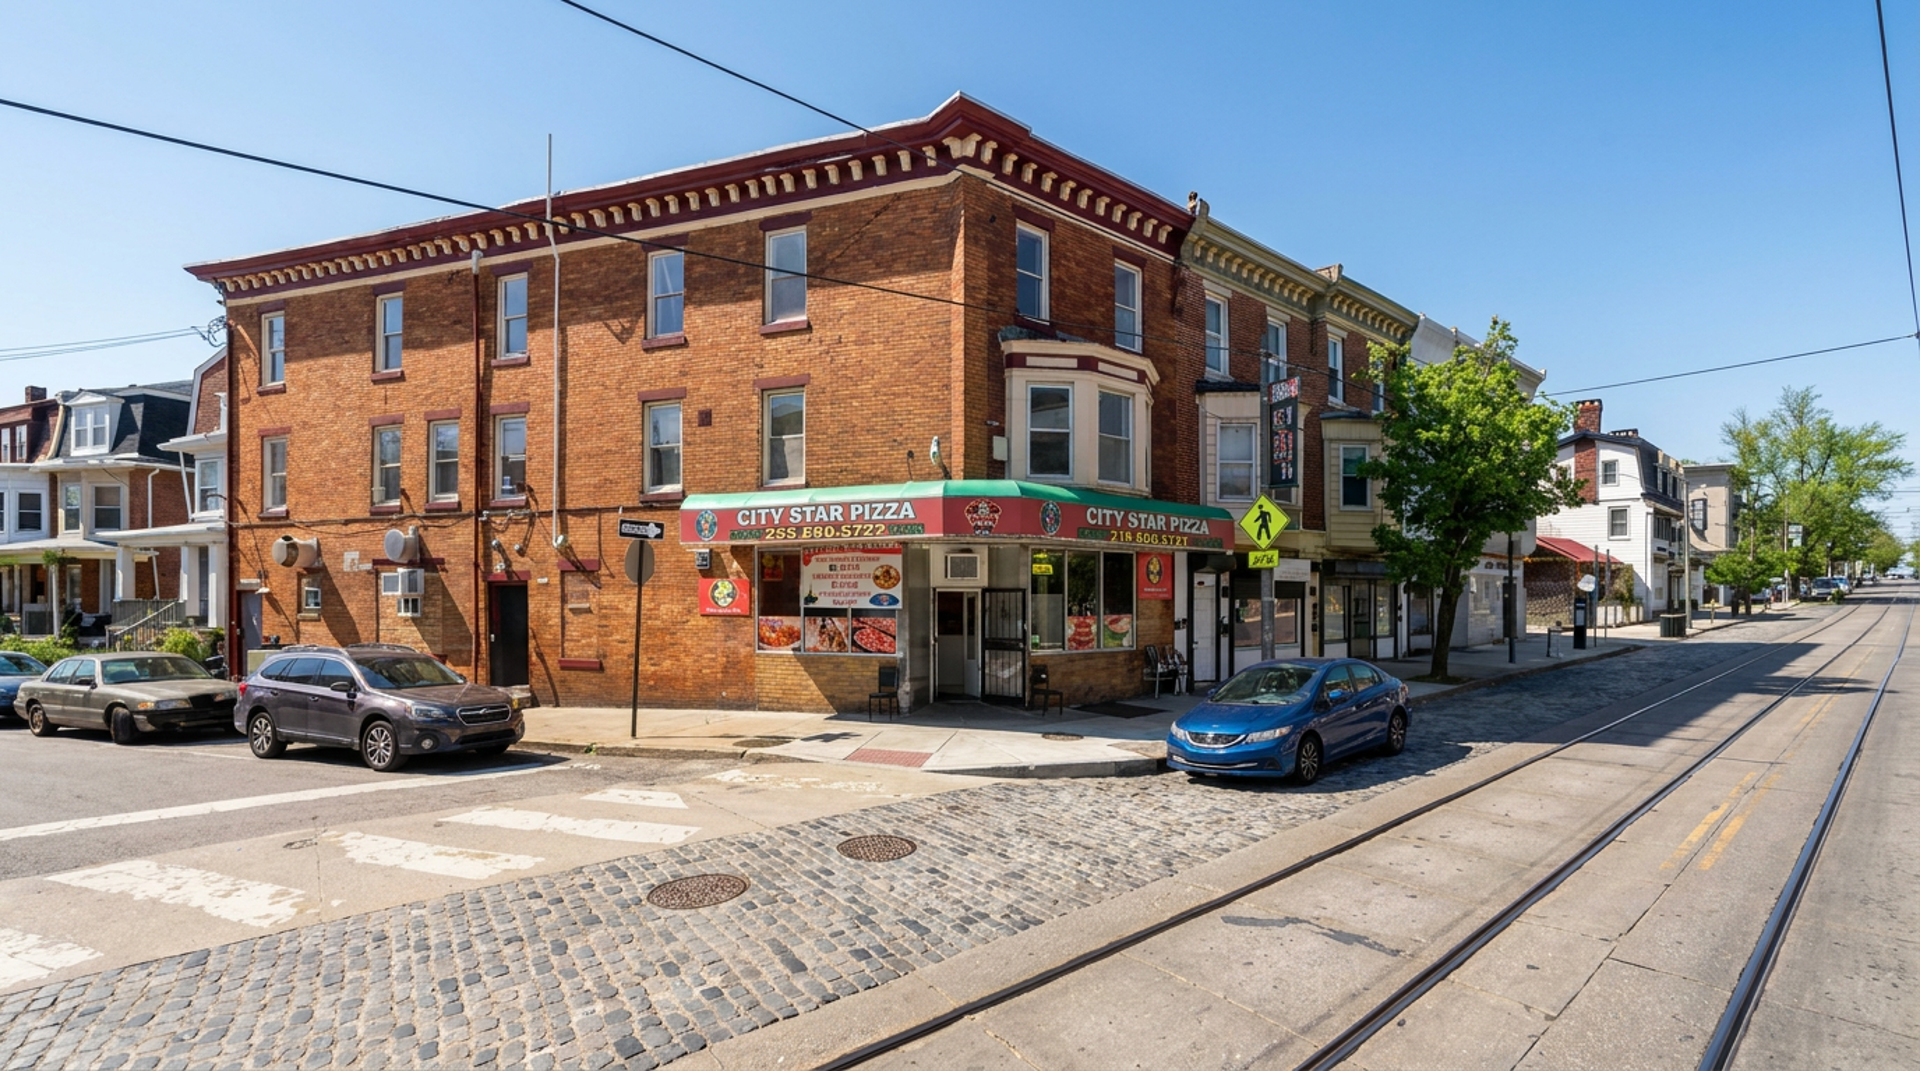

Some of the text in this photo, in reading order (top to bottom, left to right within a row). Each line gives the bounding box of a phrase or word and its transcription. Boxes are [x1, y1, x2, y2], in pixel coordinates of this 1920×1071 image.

[737, 501, 916, 526] CITY STAR PIZZA
[1086, 507, 1125, 527] CITY
[1128, 512, 1167, 531] STAR
